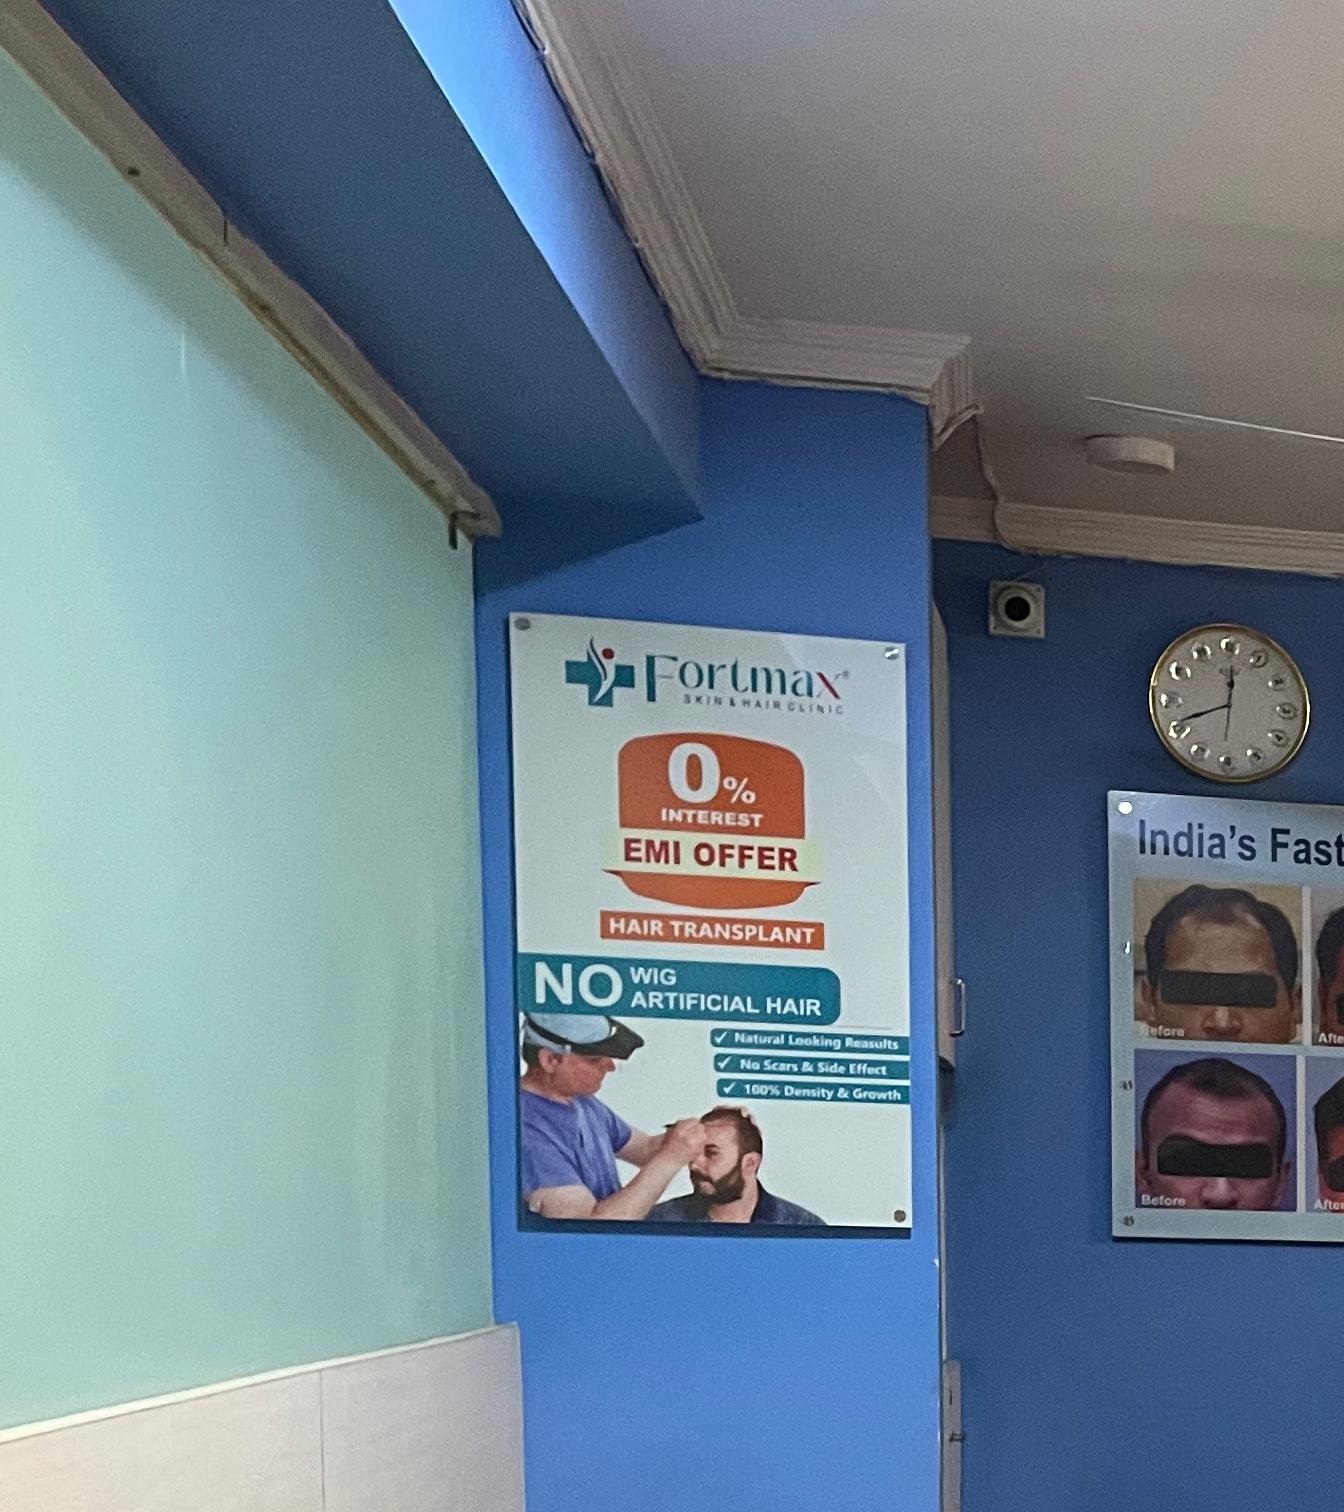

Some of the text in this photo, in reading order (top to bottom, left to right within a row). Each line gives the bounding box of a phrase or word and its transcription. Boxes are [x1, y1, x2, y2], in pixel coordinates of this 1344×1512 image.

[683, 693, 723, 706] SKIN
[742, 700, 782, 710] HAIR
[787, 703, 845, 716] CLINIC
[661, 807, 764, 828] INTEREST
[1138, 819, 1257, 862] India's
[624, 838, 799, 872] EMI OFFER
[609, 917, 816, 944] HAIR TRANSPLANT
[534, 961, 624, 1008] NO
[630, 966, 677, 987] WIG
[630, 991, 822, 1017] ARTIFICIAL HAIR
[734, 1032, 785, 1045] Natural
[788, 1034, 842, 1050] Looking
[739, 1059, 887, 1076] No Scars & Side Effect
[744, 1083, 902, 1101] 100% Density & Growth
[1141, 1194, 1186, 1207] Before
